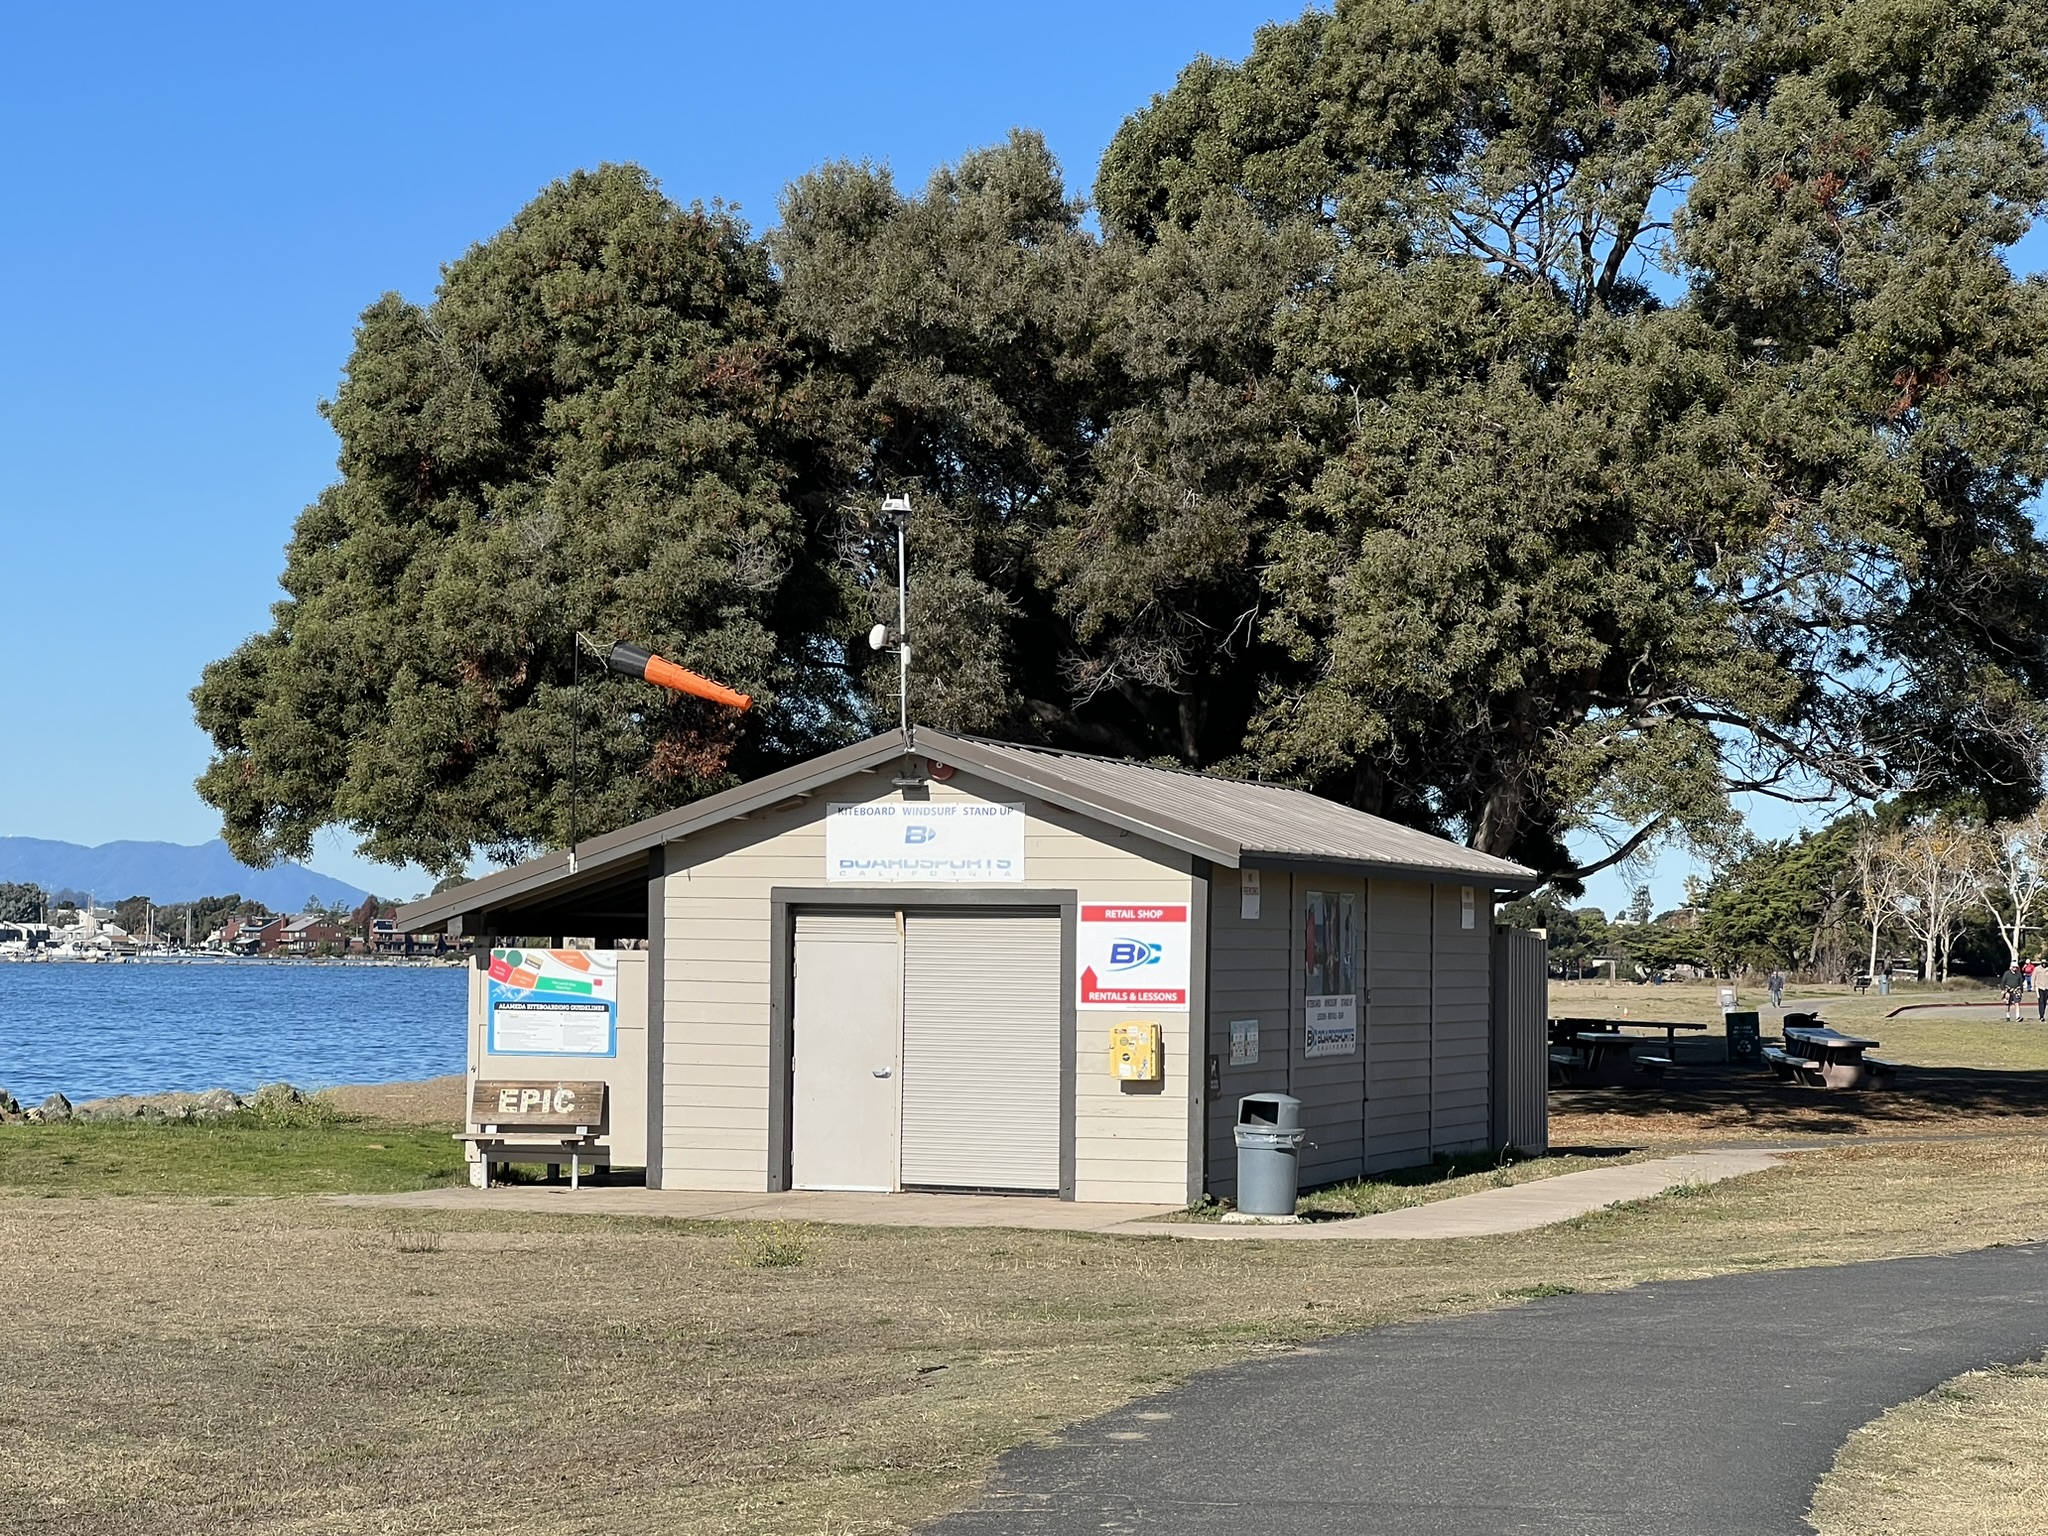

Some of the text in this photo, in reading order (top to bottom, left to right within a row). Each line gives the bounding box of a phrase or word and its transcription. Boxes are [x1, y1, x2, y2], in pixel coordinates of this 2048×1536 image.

[837, 806, 1014, 816] KITEBOARD WINDSURF STAND UP
[1105, 909, 1163, 919] RETAIL SHOP
[1089, 992, 1177, 1001] RENTALS & LESSONS
[498, 1088, 575, 1113] EPIC
